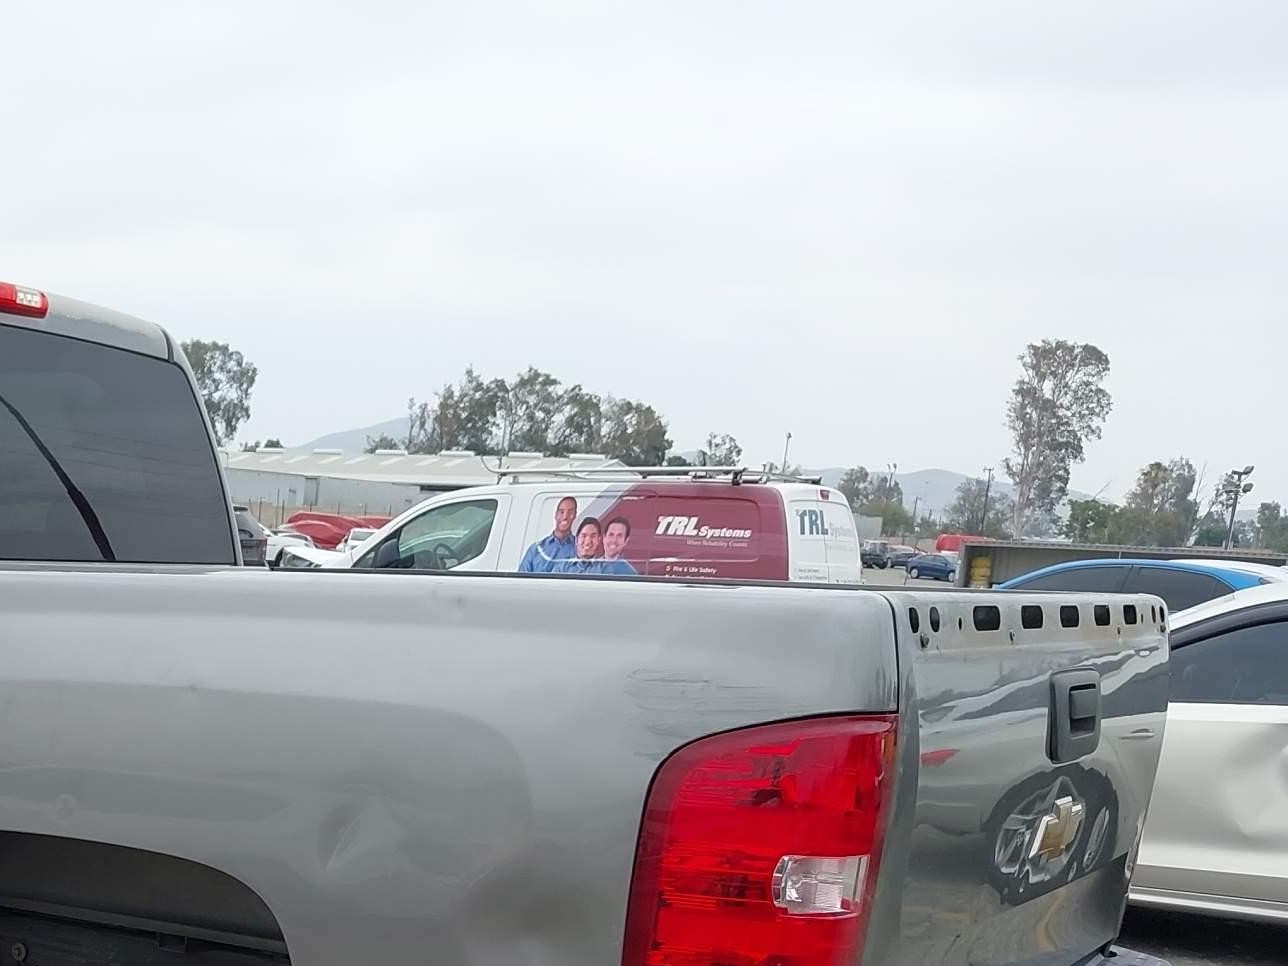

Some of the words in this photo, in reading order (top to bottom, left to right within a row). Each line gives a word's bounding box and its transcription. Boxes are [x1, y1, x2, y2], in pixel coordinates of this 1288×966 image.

[655, 516, 699, 536] TRL
[699, 526, 752, 538] Systems
[796, 509, 828, 535] TRL
